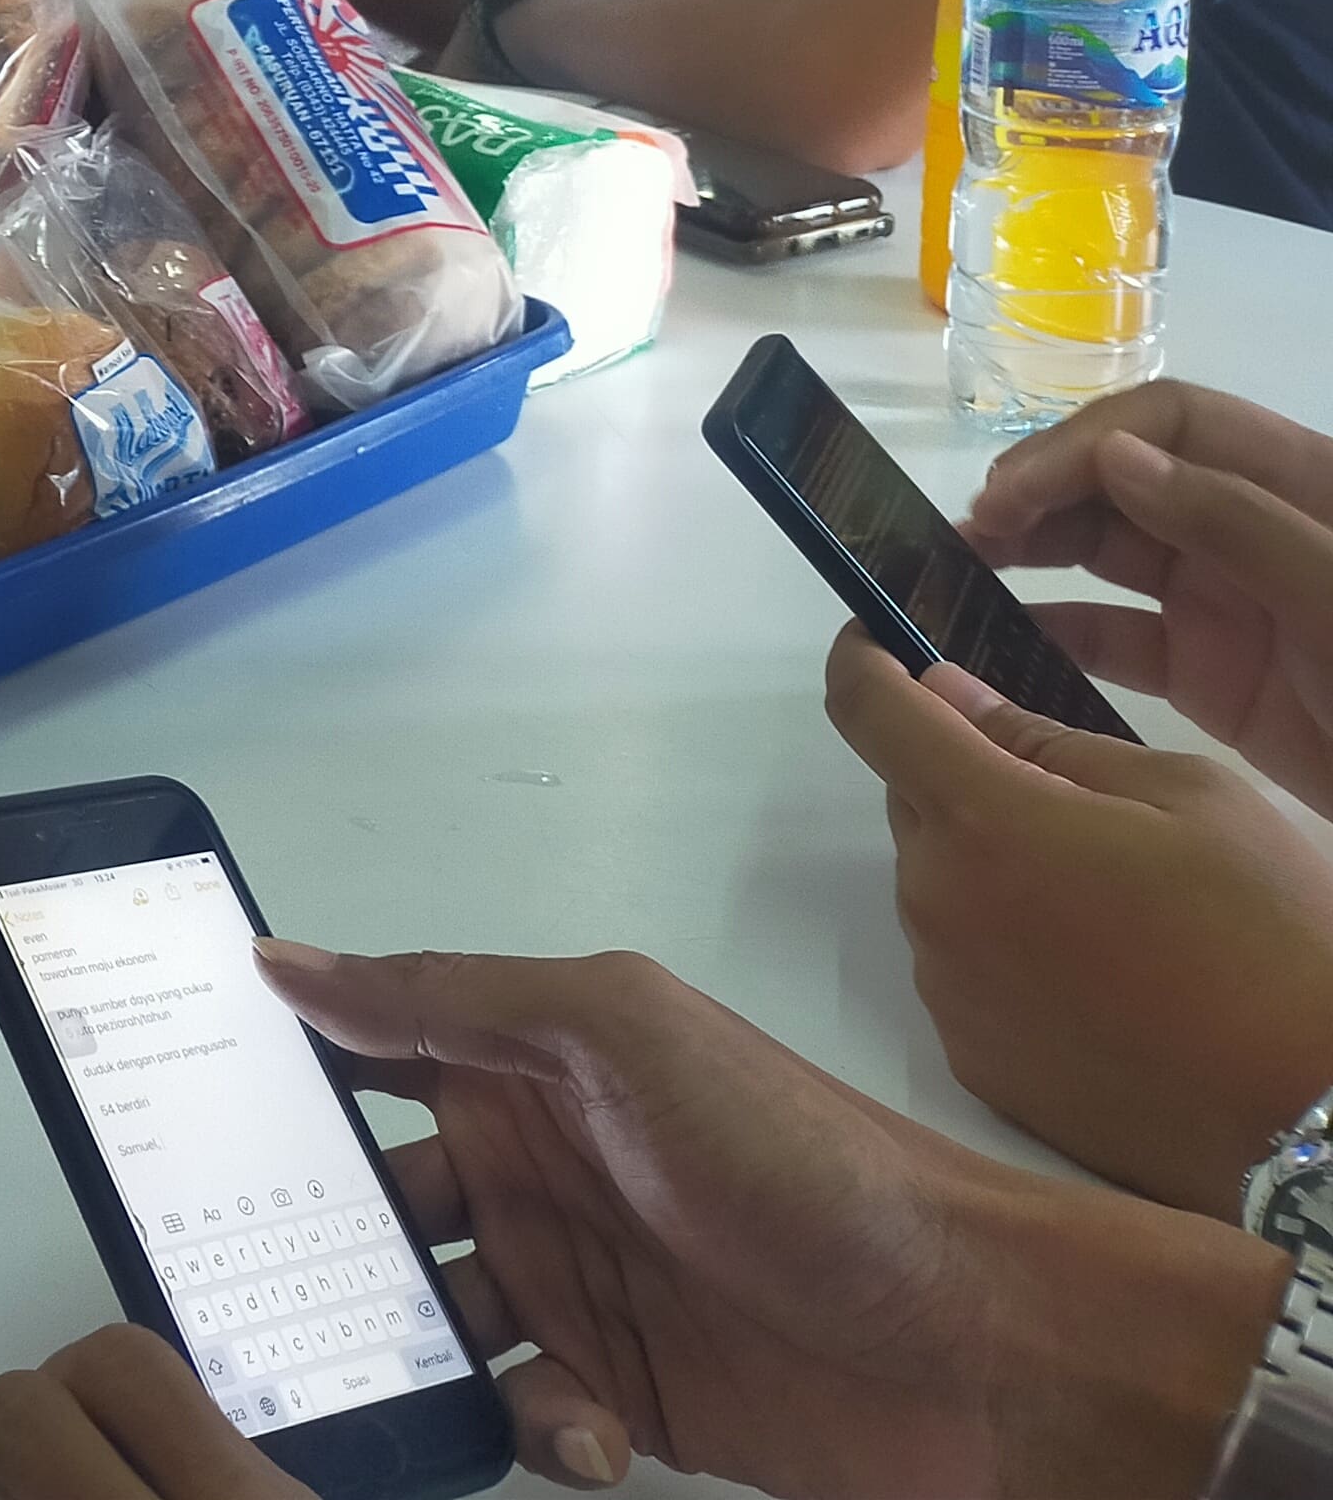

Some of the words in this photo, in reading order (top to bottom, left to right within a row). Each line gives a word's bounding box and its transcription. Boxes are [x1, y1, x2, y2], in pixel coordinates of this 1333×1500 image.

[255, 44, 312, 122] PASURUAN
[308, 129, 346, 176] 67131
[286, 38, 334, 104] SOEKARNO
[333, 112, 362, 150] HATTA
[297, 77, 325, 117] (0343)
[13, 910, 45, 924] Notes
[193, 879, 221, 894] Done
[23, 931, 49, 945] even
[31, 947, 77, 965] pameran
[38, 964, 88, 982] tawarkan
[88, 959, 114, 975] maju
[114, 951, 158, 969] ekonomi
[90, 997, 127, 1016] sumber
[129, 992, 155, 1009] daya
[156, 988, 182, 1004] yang
[183, 981, 214, 996] cukup
[83, 1060, 116, 1079] duduk
[117, 1054, 157, 1072] dengan
[157, 1049, 182, 1065] para
[182, 1036, 238, 1060] pengusaha
[100, 1103, 116, 1117] 54
[116, 1096, 150, 1114] berdiri
[202, 1206, 222, 1224] Aa
[342, 1374, 371, 1391] Spasi
[414, 1348, 454, 1371] Kembali
